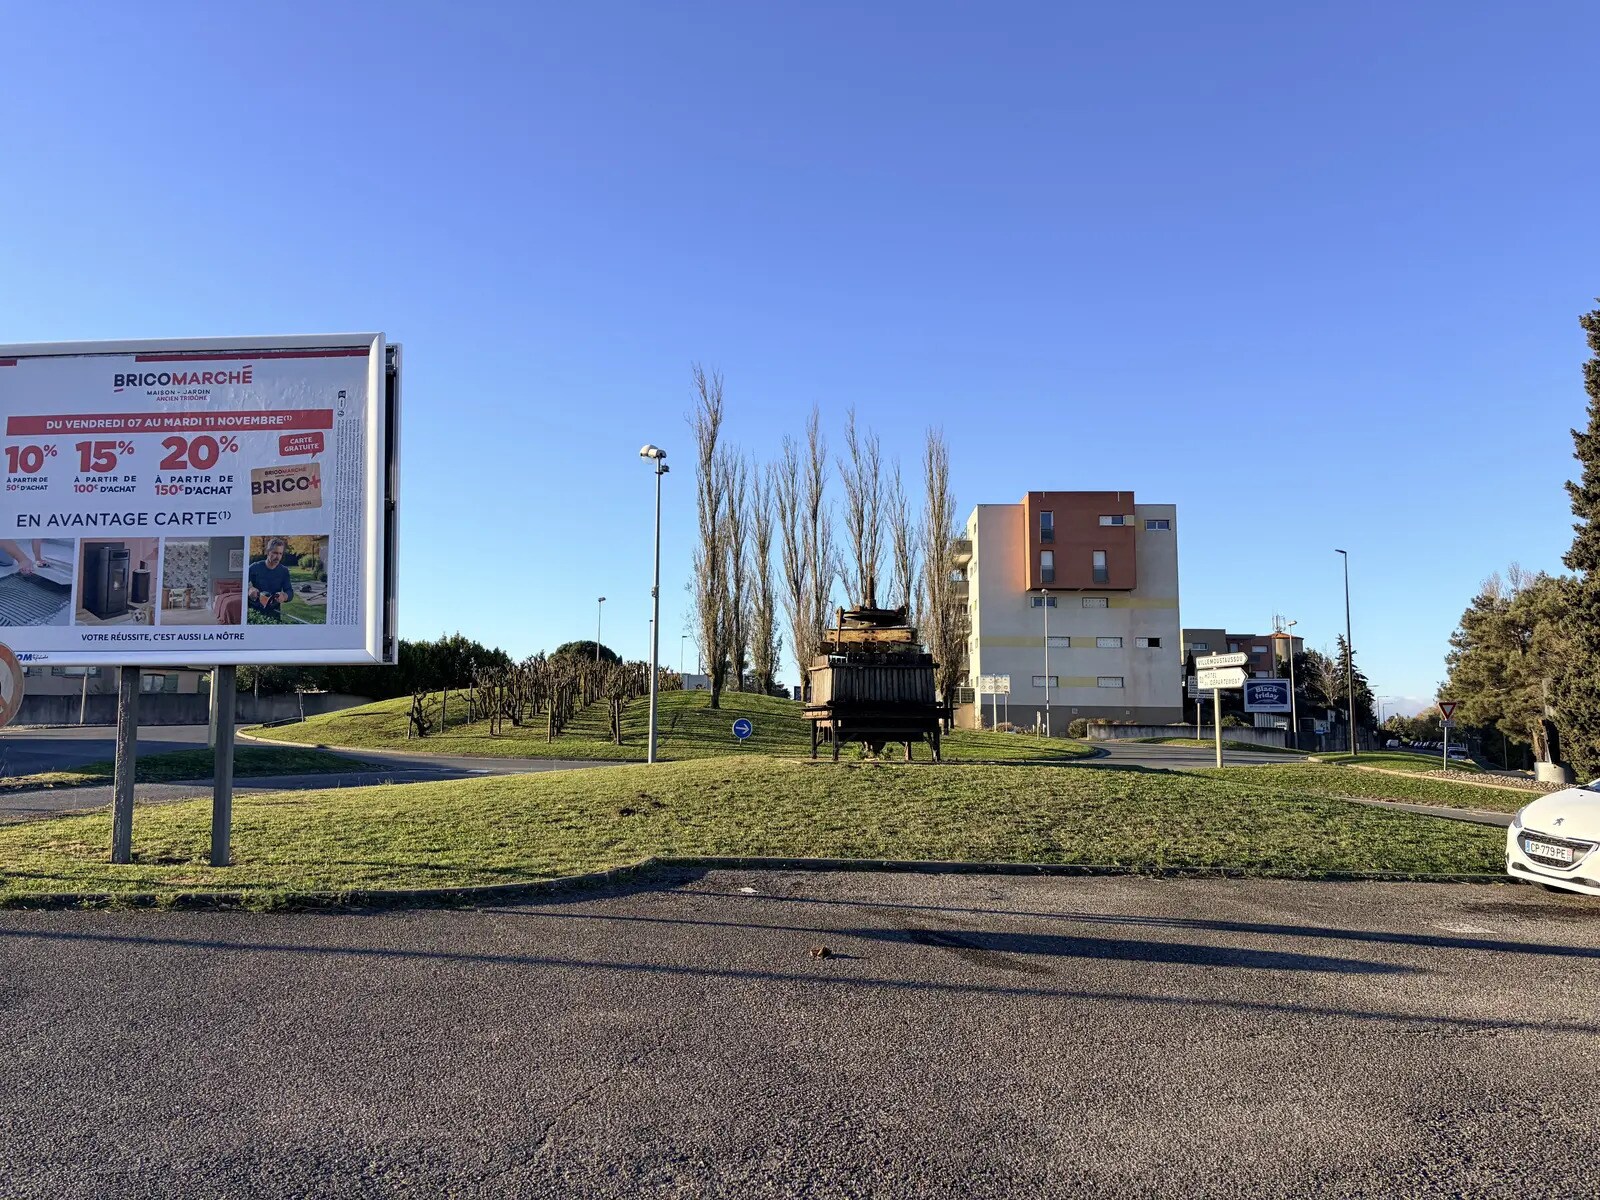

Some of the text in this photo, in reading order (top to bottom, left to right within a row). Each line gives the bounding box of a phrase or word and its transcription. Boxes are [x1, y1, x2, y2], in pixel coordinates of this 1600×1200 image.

[114, 365, 252, 392] BRICOMARCHÉ
[46, 420, 62, 430] DU
[66, 419, 124, 429] VENDREDI
[128, 418, 142, 428] 07
[144, 418, 161, 427] AU
[164, 417, 202, 427] MARDI
[205, 416, 214, 426] 11
[160, 435, 239, 470] 20%
[284, 443, 319, 452] GRATUITE
[5, 444, 58, 474] 10%
[75, 440, 135, 472] 15%
[155, 475, 162, 483] À
[185, 486, 233, 495] D'ACHAT
[16, 514, 41, 527] EN
[47, 512, 148, 527] AVANTAGE
[111, 632, 151, 641] RÉUSSITE,
[216, 631, 245, 640] NÔTRE
